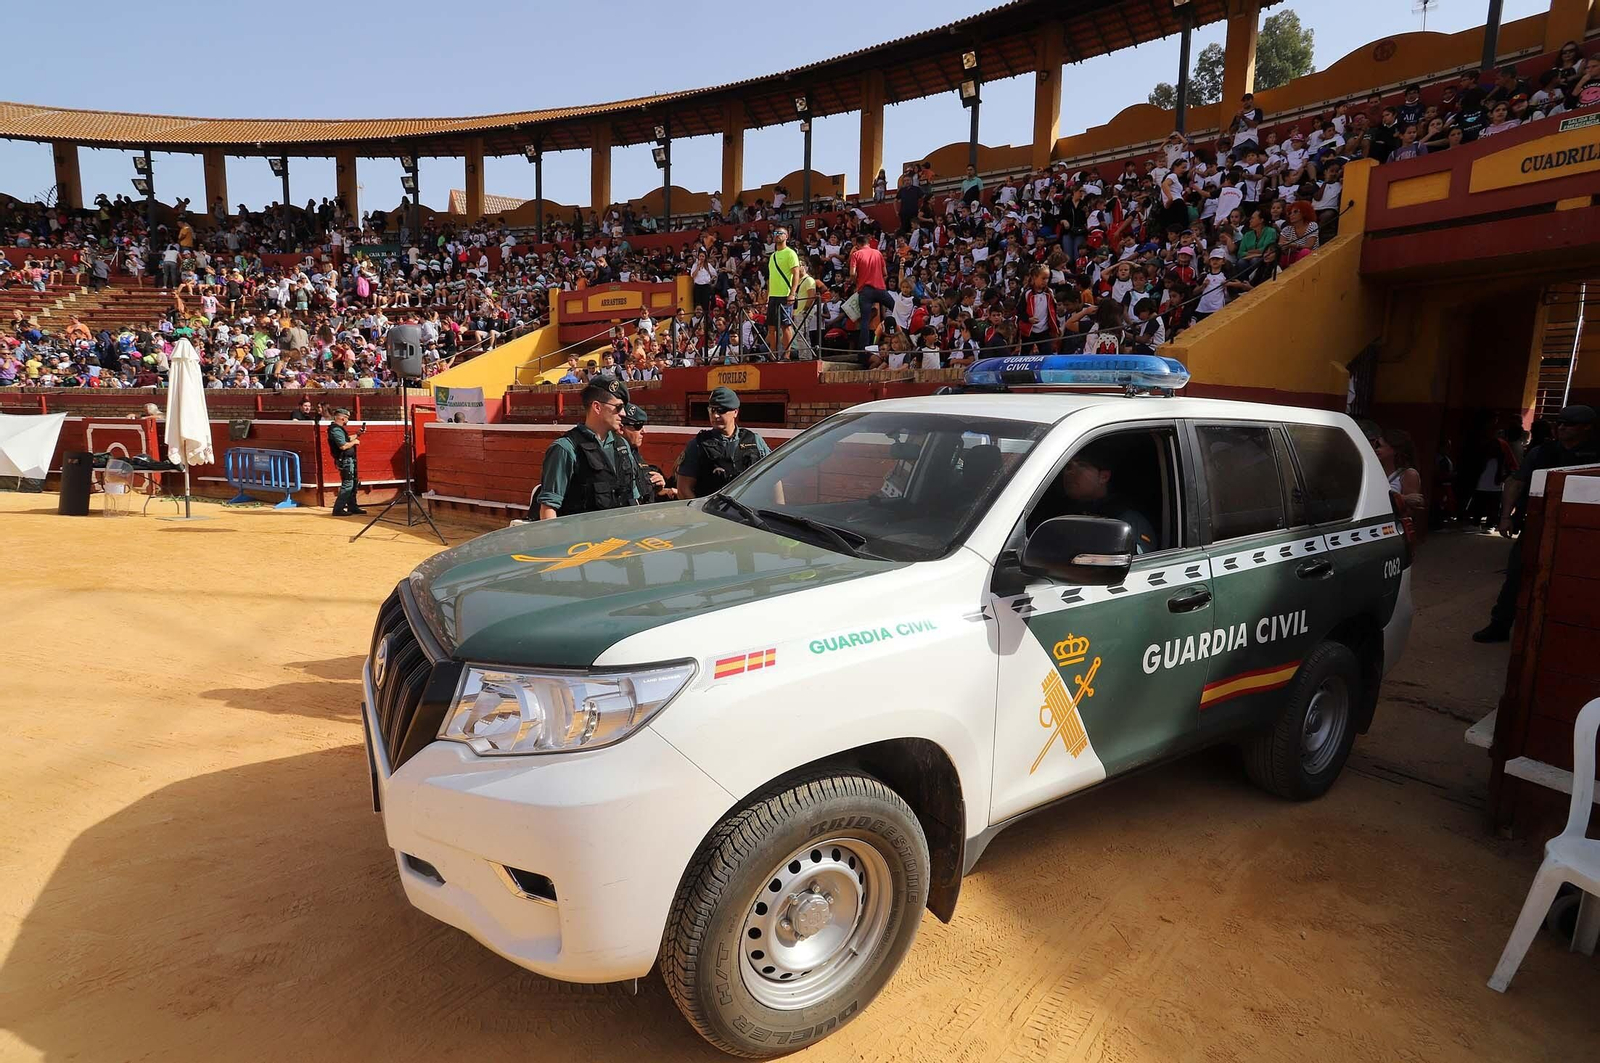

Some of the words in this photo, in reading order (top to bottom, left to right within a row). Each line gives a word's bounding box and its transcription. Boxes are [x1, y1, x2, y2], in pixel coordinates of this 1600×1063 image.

[1521, 143, 1600, 174] CUADRIL
[601, 297, 627, 306] ARRASTRES
[718, 371, 747, 384] TORILES
[809, 627, 894, 655] GUARDIA
[895, 619, 938, 636] CIVIL
[1142, 622, 1248, 675] GUARDIA
[1255, 609, 1309, 644] CIVIL
[808, 815, 920, 907] BRIDGESTONE
[715, 938, 733, 1006] H/T
[732, 999, 860, 1046] DUELER
